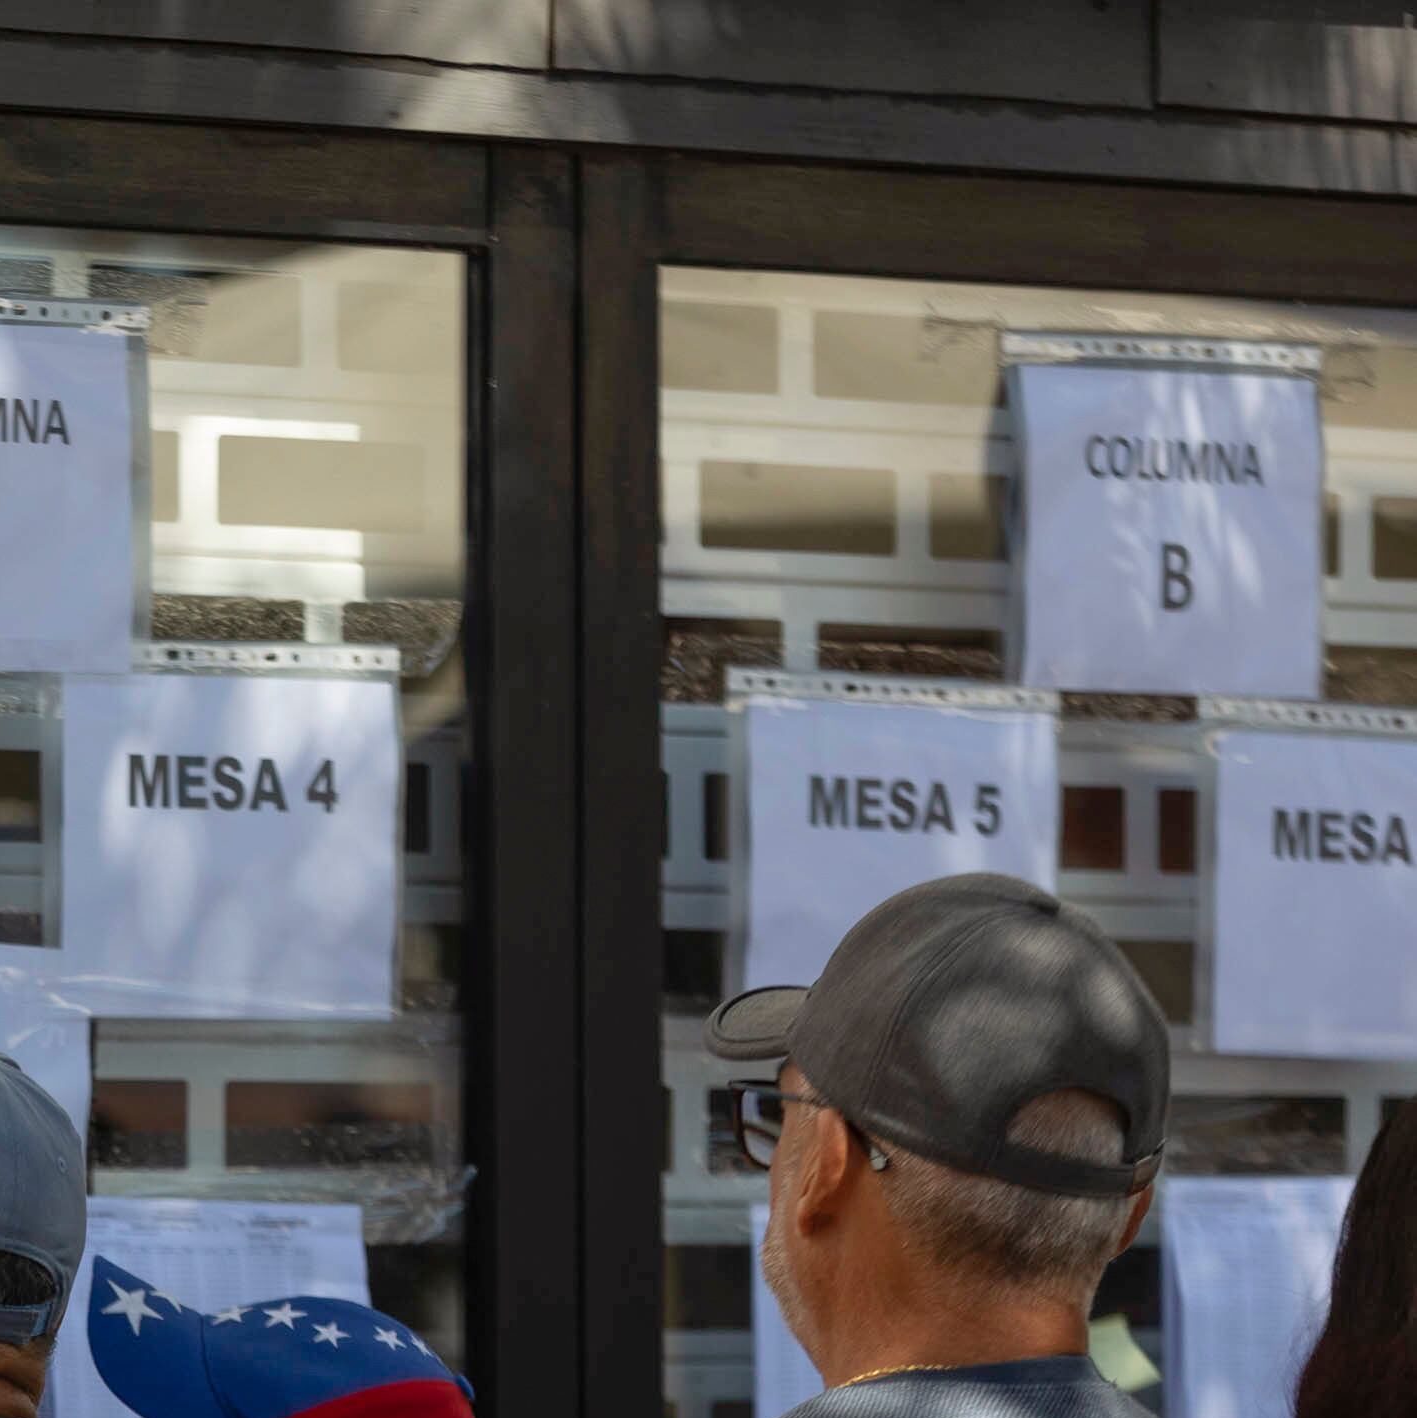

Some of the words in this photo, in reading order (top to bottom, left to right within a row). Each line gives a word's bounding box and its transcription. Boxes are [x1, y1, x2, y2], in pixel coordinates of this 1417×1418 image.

[1084, 434, 1265, 487] COLUMNA
[1160, 542, 1195, 612] B
[129, 754, 288, 811] MESA
[307, 759, 337, 813] 4
[810, 775, 955, 832] MESA
[975, 784, 1002, 837] 5
[1273, 808, 1413, 867] MESA
